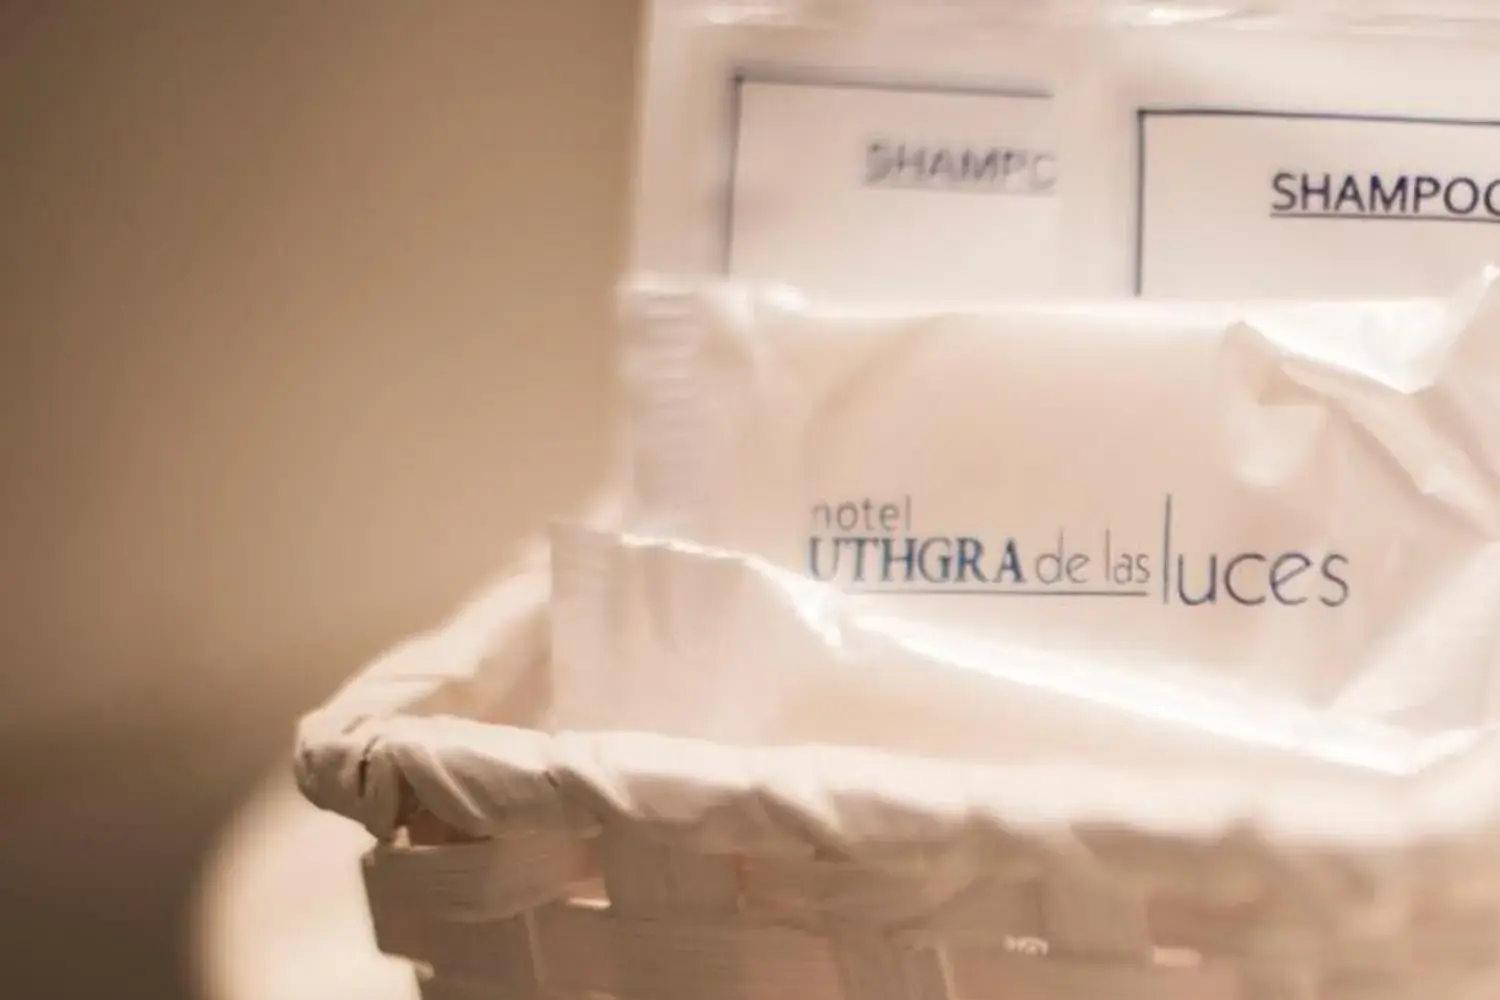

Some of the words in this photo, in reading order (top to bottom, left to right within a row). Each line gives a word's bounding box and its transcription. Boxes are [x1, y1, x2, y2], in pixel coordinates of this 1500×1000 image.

[864, 141, 1057, 190] SHAMPO
[808, 536, 1027, 584] UTHGRA
[1034, 529, 1091, 584] de
[1104, 527, 1151, 585] las
[1163, 493, 1350, 607] luces
